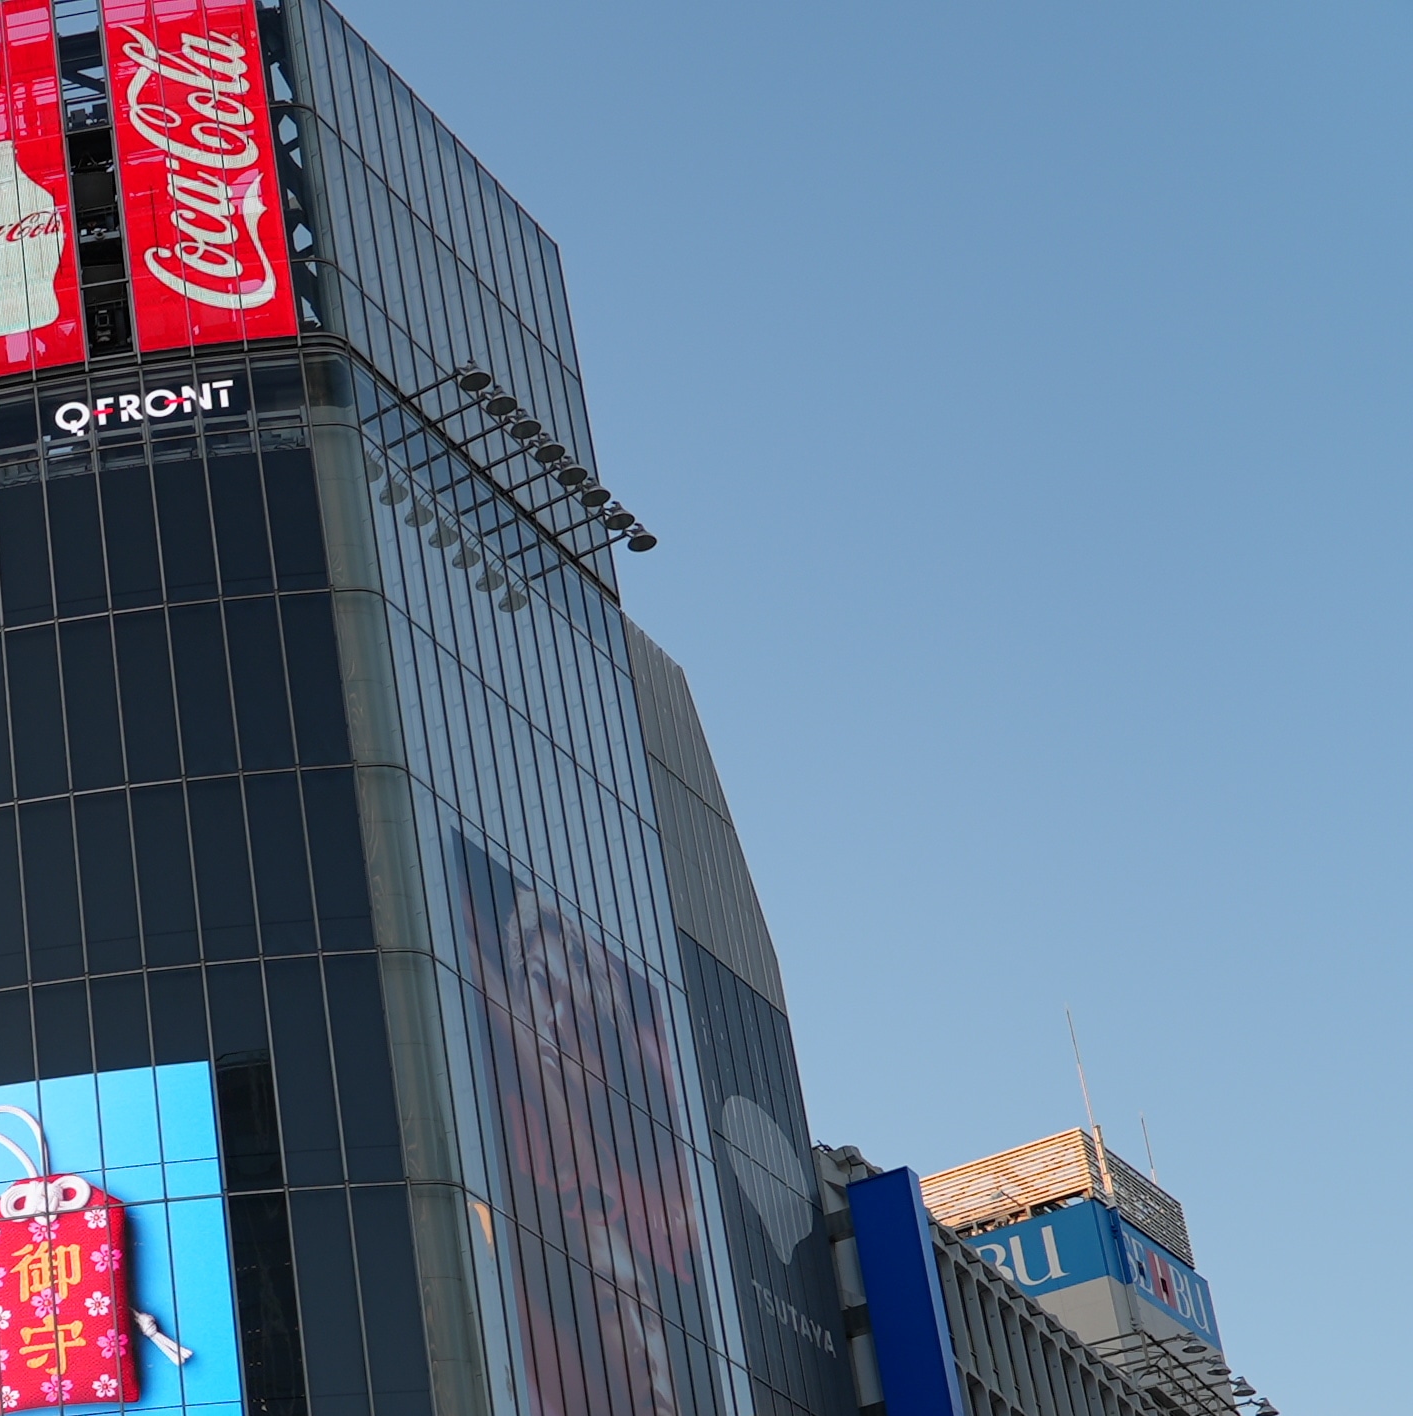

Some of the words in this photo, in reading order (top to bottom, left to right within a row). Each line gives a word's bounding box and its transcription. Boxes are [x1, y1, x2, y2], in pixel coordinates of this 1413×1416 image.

[121, 23, 276, 310] Coca-Cola
[54, 379, 233, 436] QFRONT
[11, 1241, 86, 1375] 御守
[752, 1277, 838, 1360] TSUTAYA
